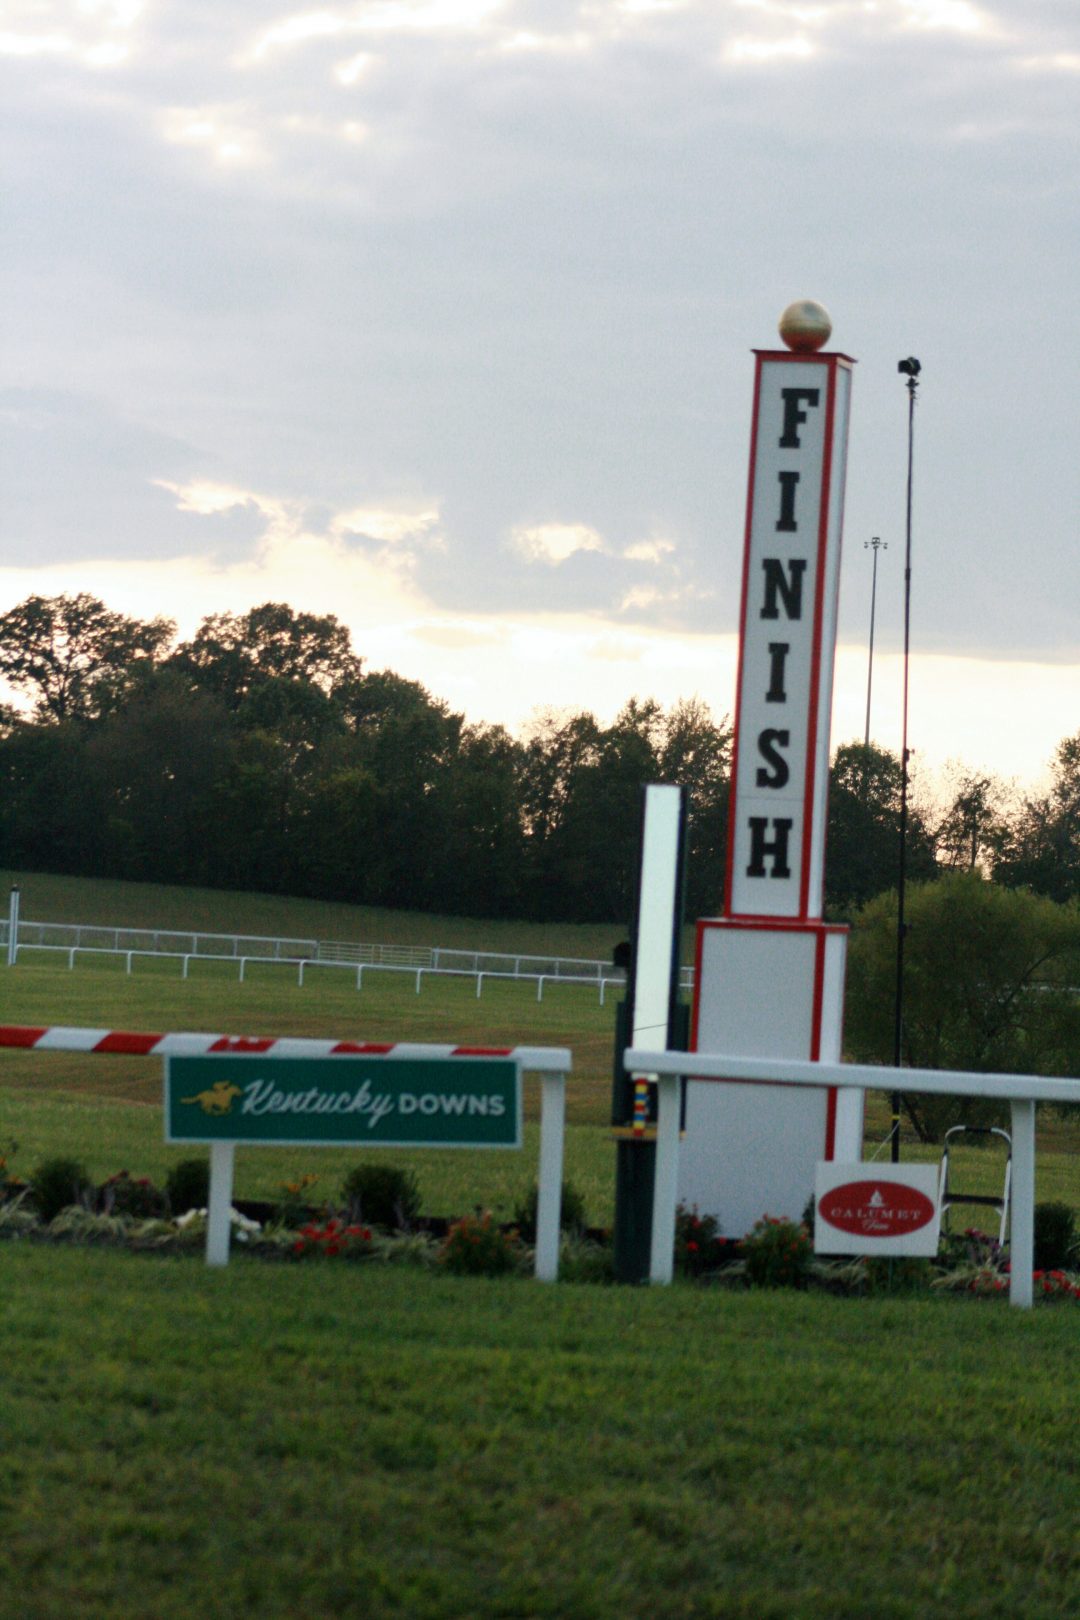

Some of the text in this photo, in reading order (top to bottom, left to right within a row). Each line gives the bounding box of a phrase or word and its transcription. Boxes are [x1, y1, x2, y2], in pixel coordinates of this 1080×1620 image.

[746, 387, 820, 878] FINISH
[242, 1079, 506, 1129] Kentucky DOWNS
[830, 1207, 922, 1220] CALUMET
